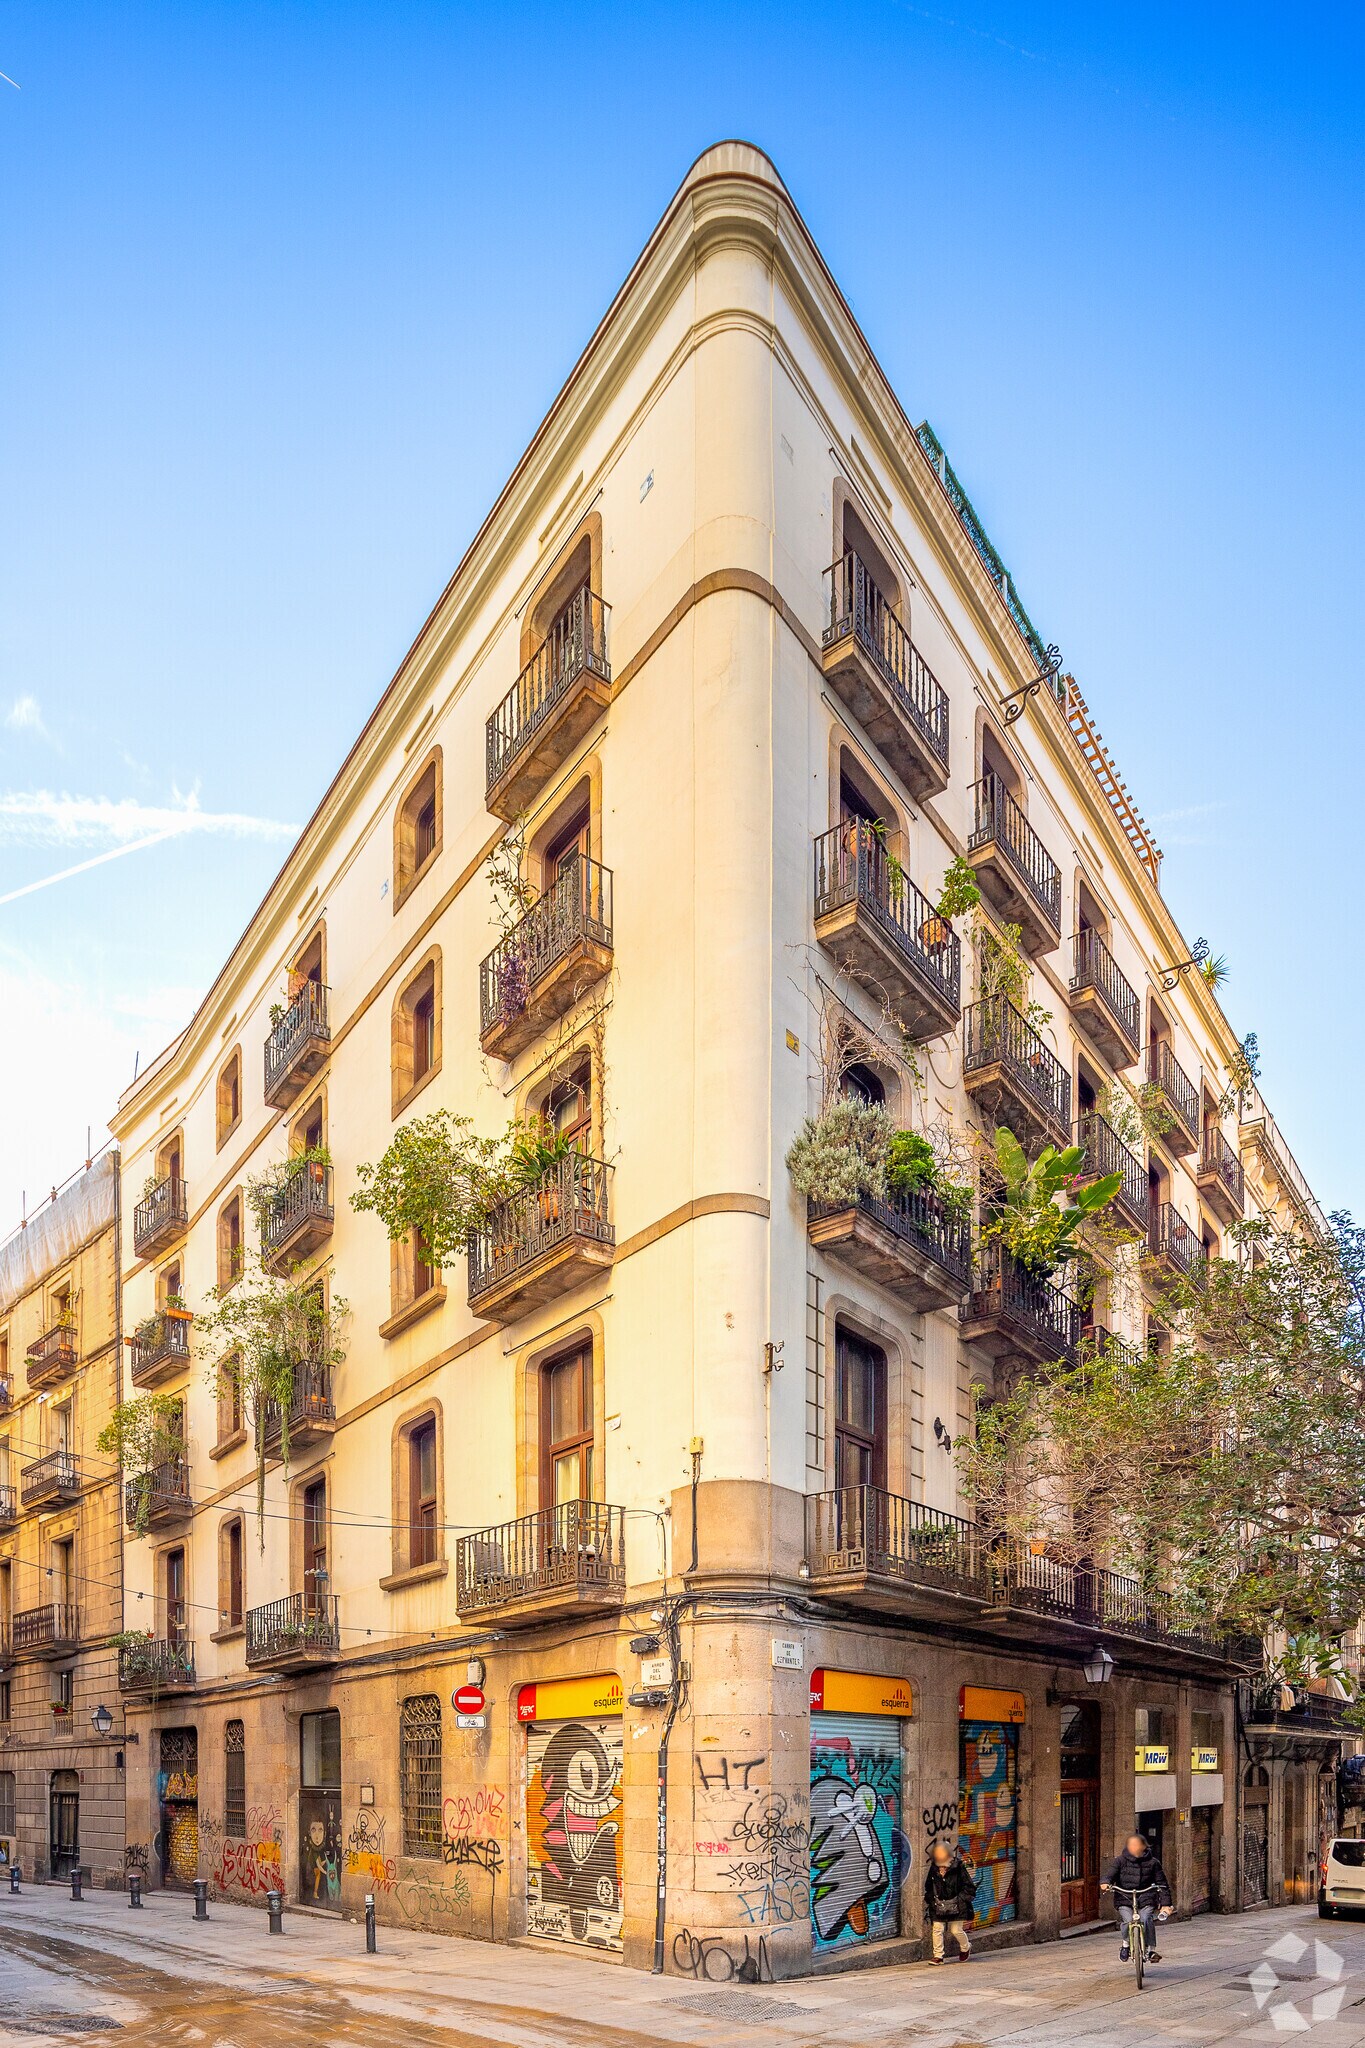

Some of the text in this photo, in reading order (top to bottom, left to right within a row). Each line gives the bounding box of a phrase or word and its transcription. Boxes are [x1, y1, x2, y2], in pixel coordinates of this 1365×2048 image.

[593, 1696, 623, 1708] esquerr
[881, 1698, 909, 1709] esquerra
[1145, 1752, 1168, 1764] MRW
[1198, 1753, 1217, 1763] MRW
